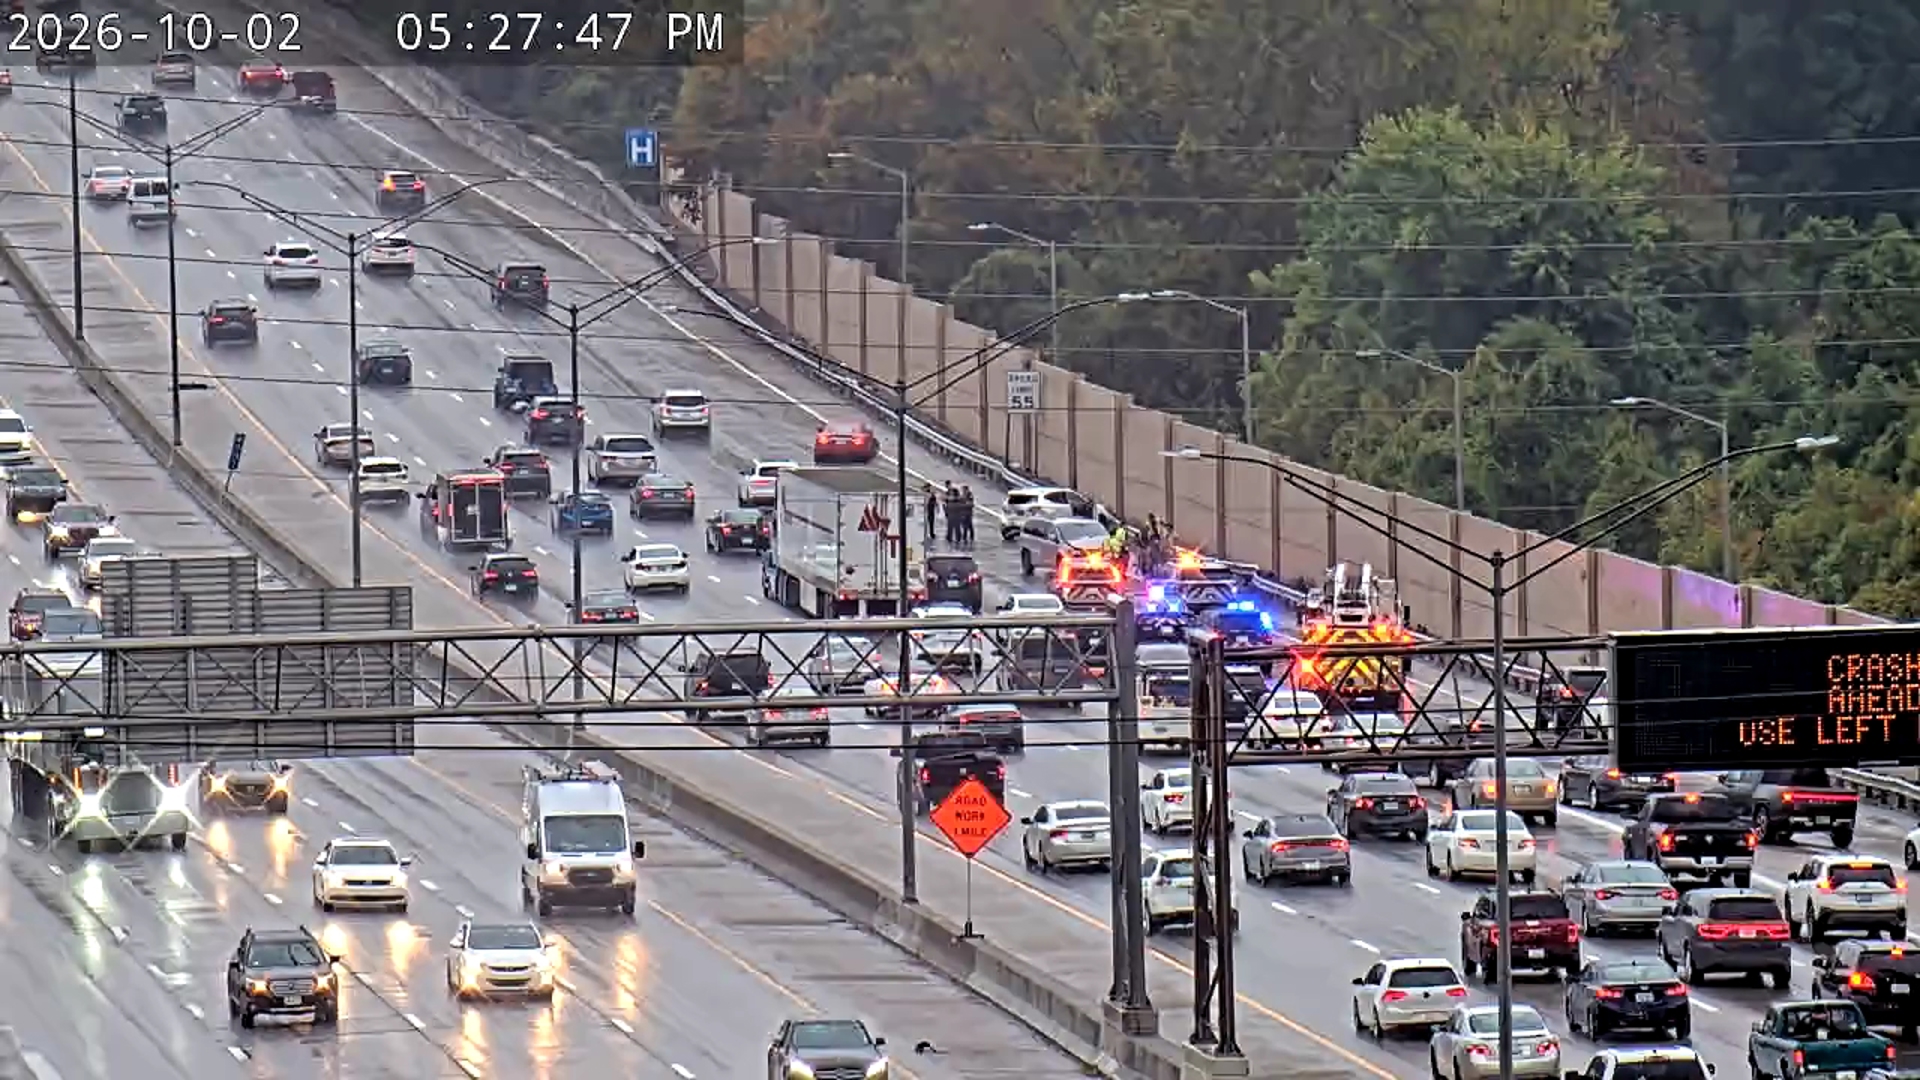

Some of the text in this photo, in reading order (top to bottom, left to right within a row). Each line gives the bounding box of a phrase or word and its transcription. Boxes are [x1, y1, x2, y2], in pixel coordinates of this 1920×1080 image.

[631, 137, 653, 163] H
[1827, 653, 1920, 682] CRASH
[1828, 683, 1920, 713] AHEAD
[1739, 717, 1795, 746] USE
[1817, 714, 1897, 744] LEFT
